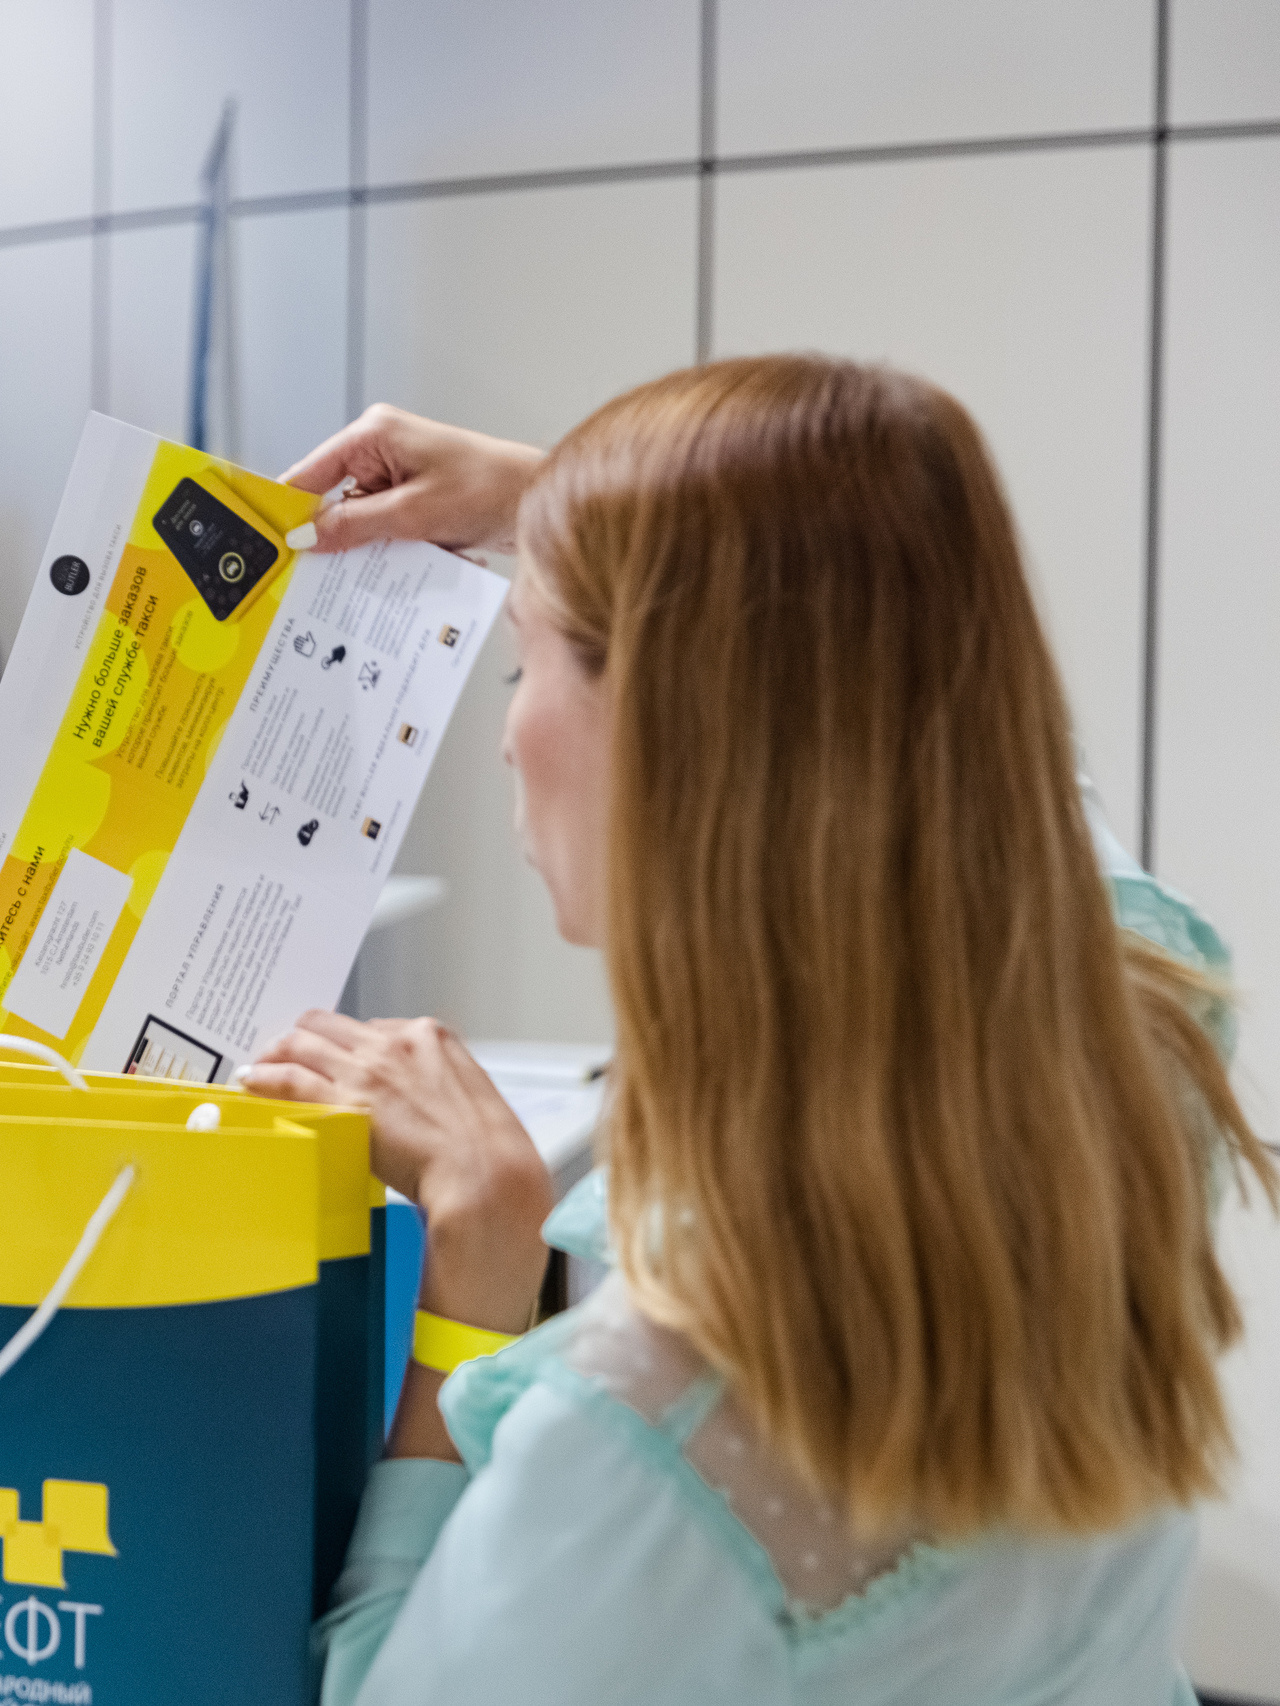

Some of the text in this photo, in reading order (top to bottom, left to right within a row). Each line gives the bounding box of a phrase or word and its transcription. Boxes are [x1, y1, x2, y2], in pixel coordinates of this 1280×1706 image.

[63, 559, 81, 592] BUTLER
[91, 580, 103, 600] ДЛЯ
[108, 522, 123, 548] ТАКСИ
[71, 564, 148, 740] Нужно больше заказов
[89, 593, 159, 748] вашей службе такси
[247, 615, 296, 712] ПРЕИМУЩЕСТВА
[16, 885, 28, 897] с
[21, 844, 46, 885] нами
[163, 960, 191, 1009] ПОРТАЛ
[185, 882, 226, 960] УПРАВЛЕНИЯ
